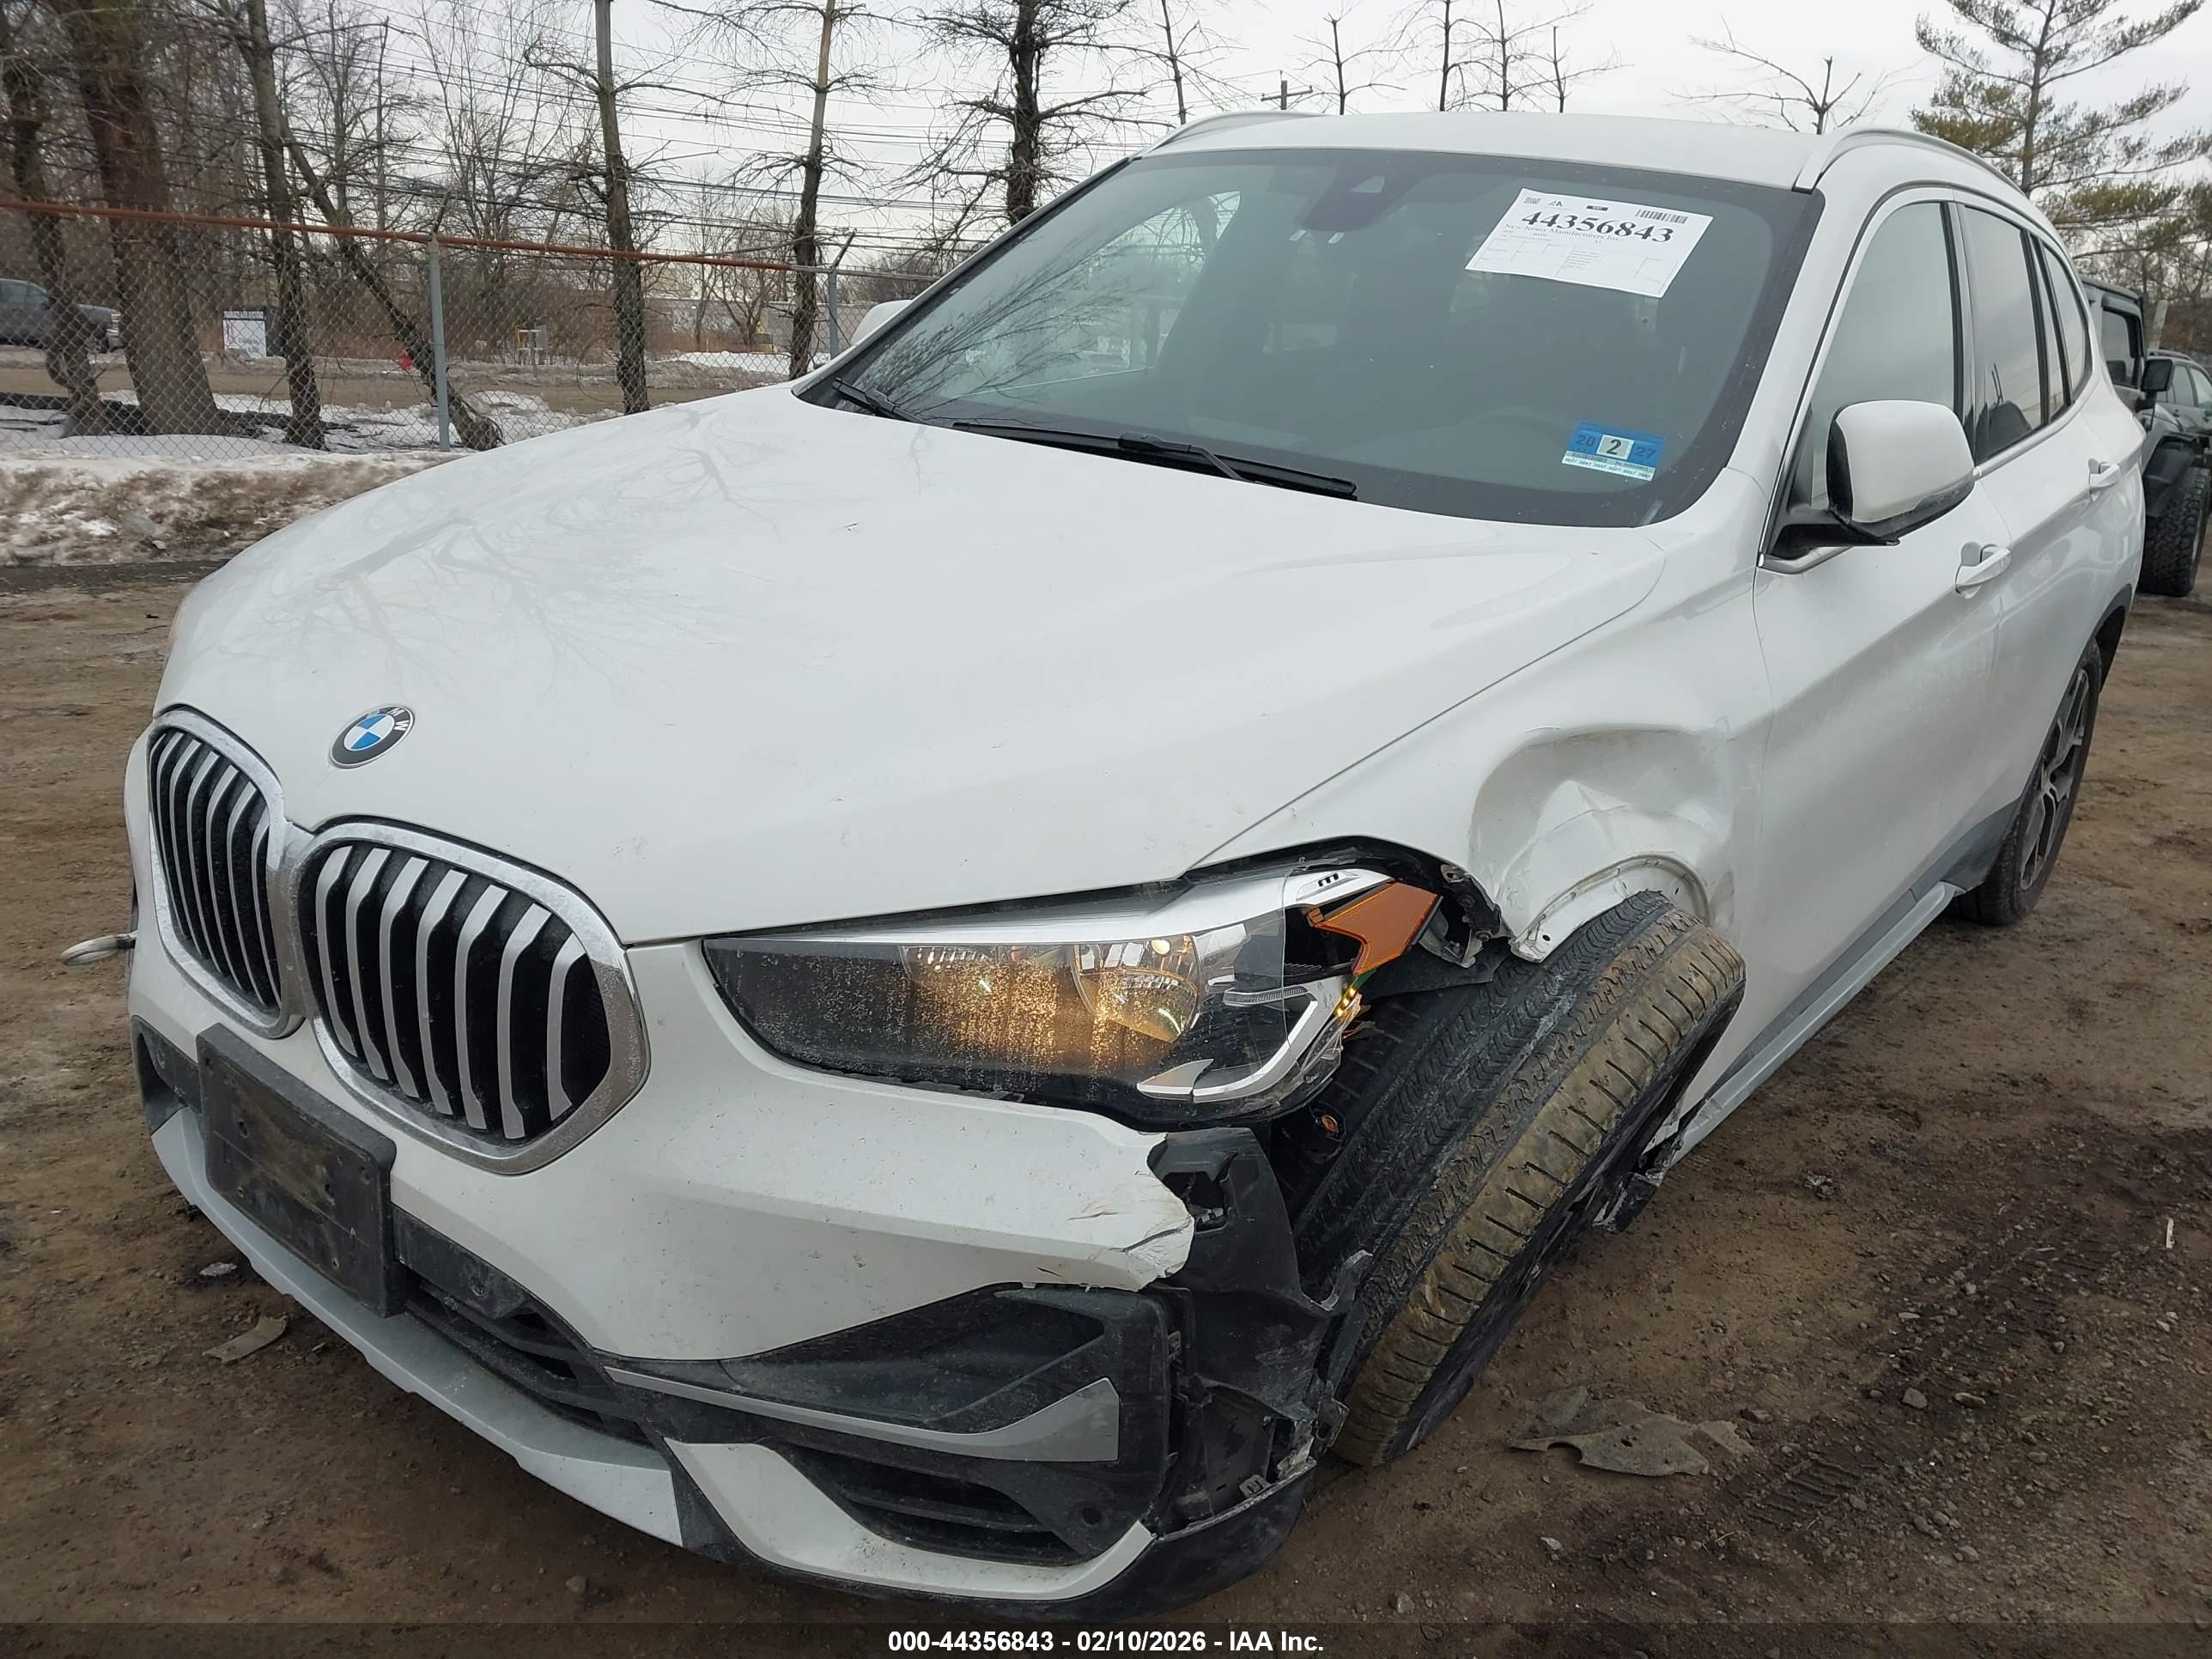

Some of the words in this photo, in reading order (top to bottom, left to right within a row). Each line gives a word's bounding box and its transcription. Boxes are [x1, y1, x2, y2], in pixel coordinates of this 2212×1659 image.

[1522, 211, 1674, 243] 44356843
[1576, 434, 1595, 447] 20
[1606, 439, 1622, 455] 2
[1634, 447, 1657, 459] 27
[366, 707, 410, 731] MW
